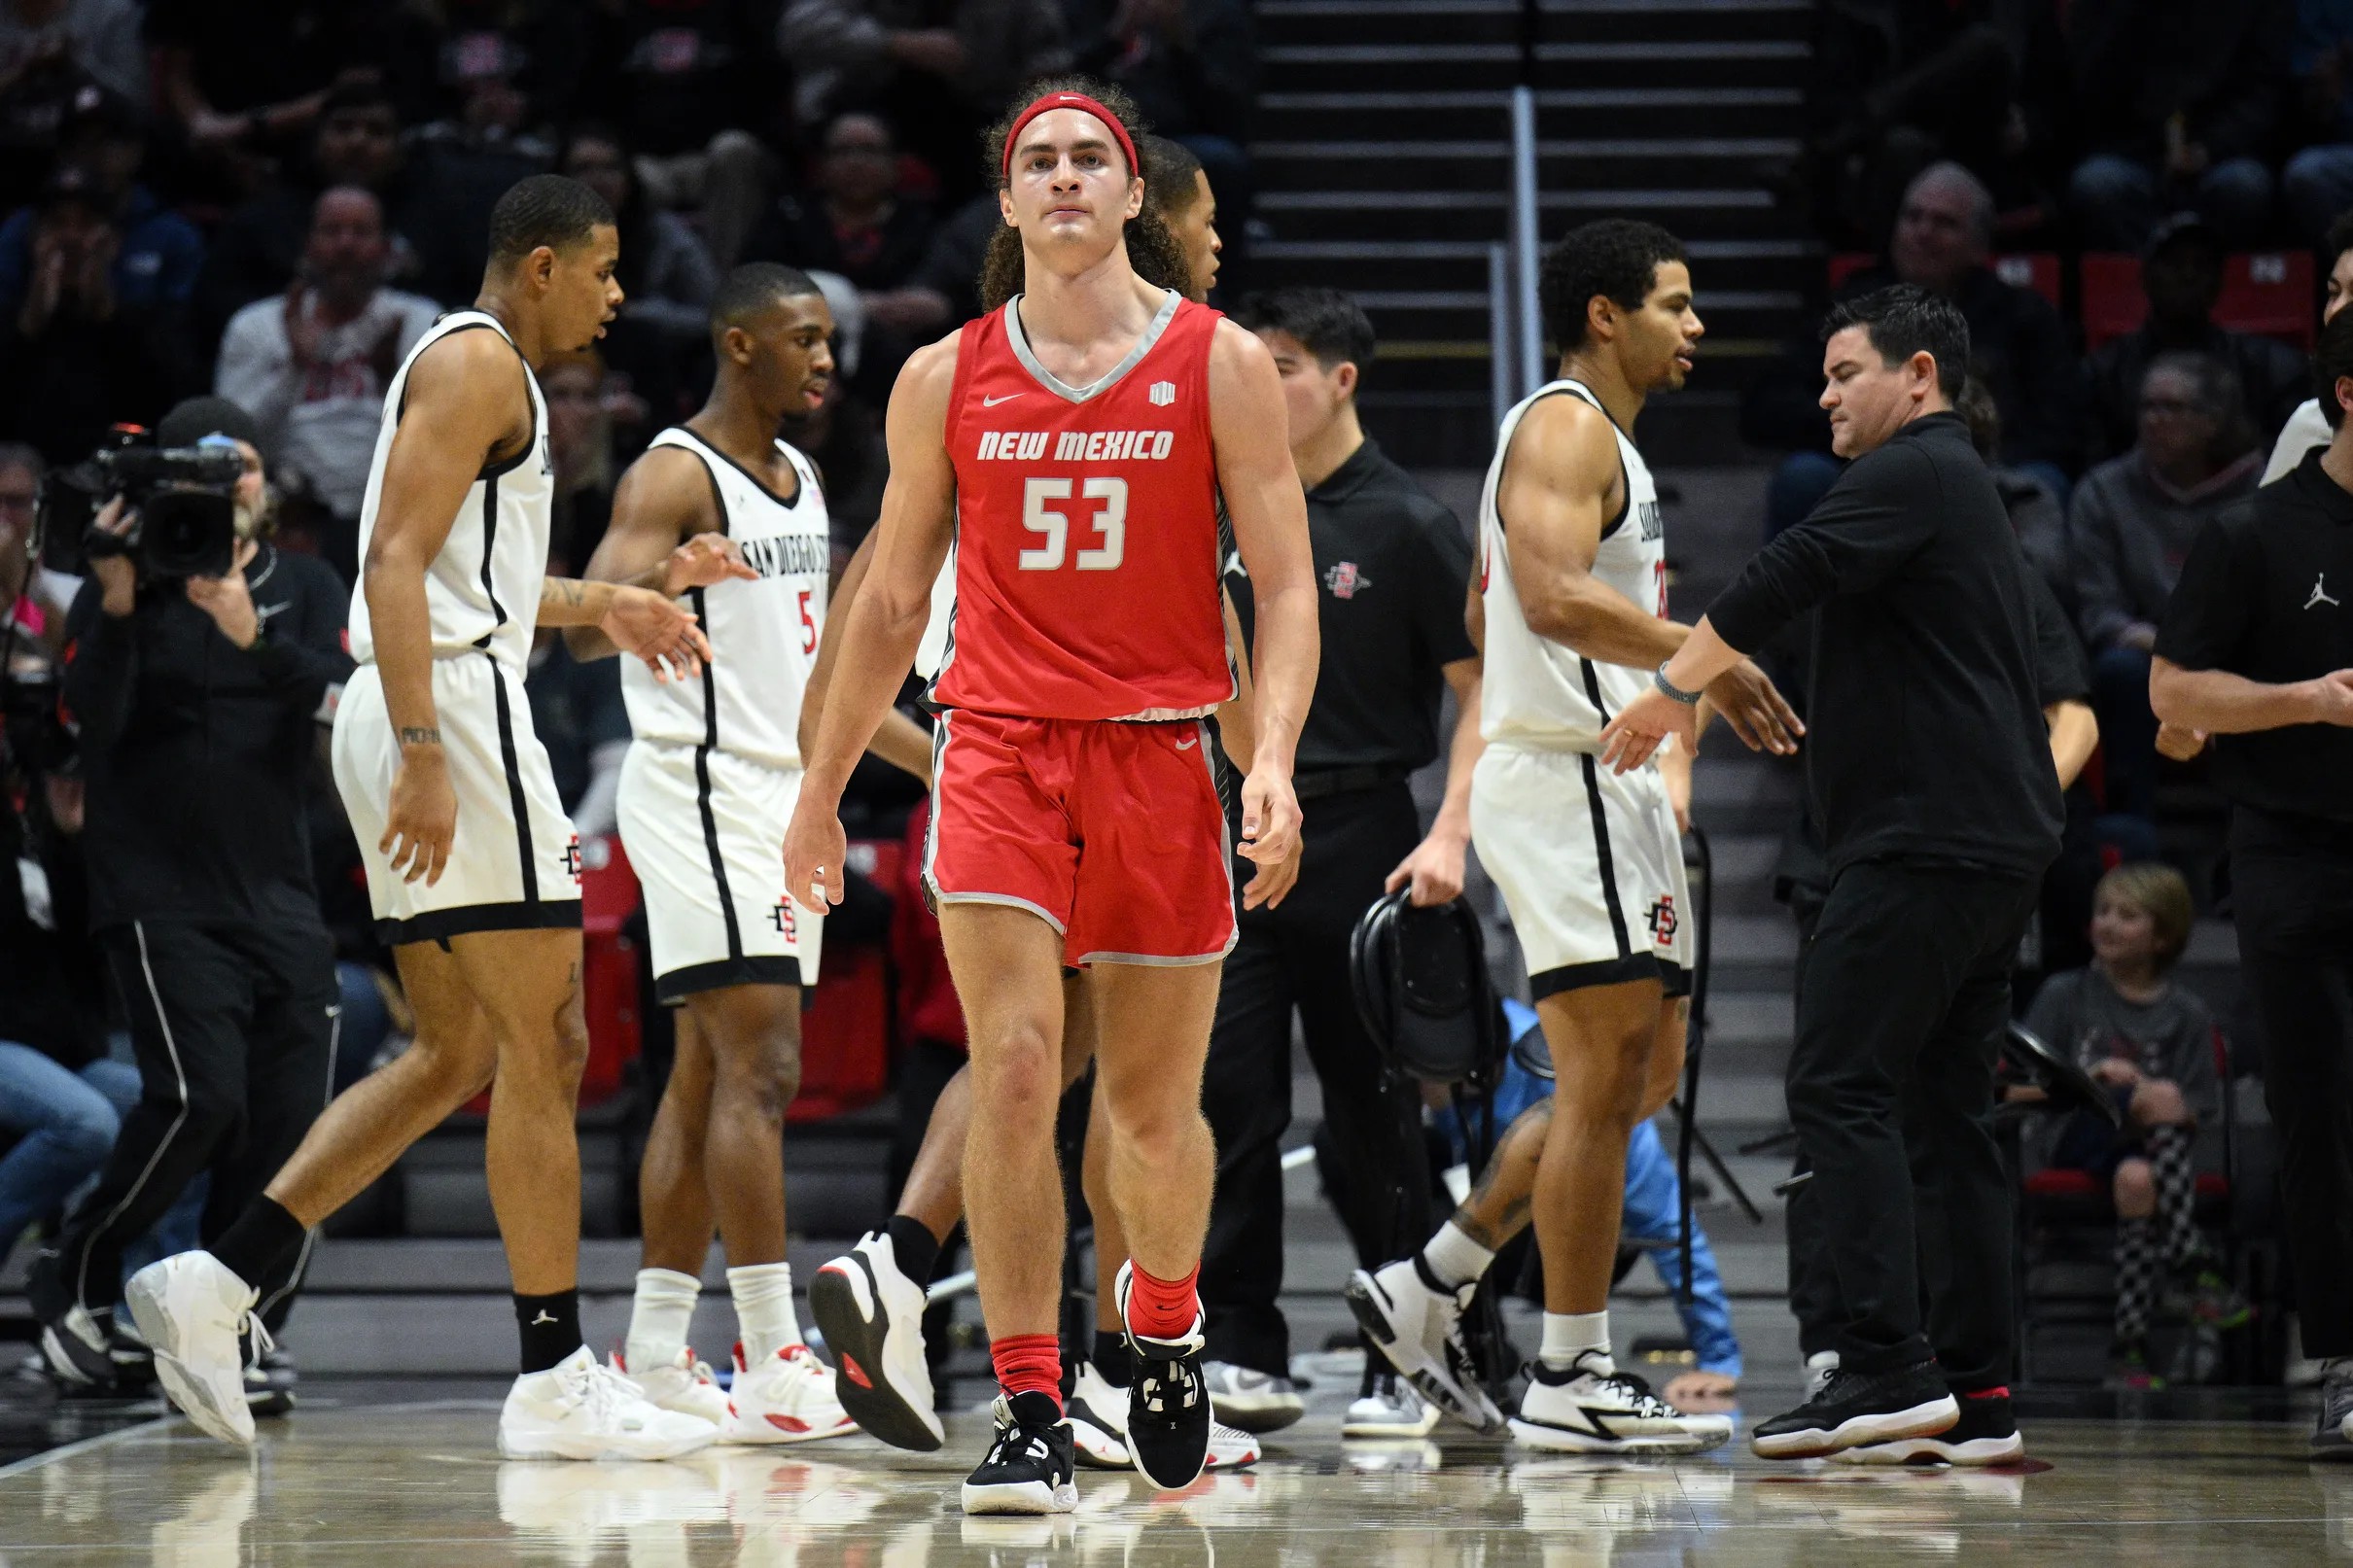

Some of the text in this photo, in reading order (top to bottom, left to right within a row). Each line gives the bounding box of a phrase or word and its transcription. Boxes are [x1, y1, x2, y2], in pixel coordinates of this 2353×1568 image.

[976, 430, 1175, 461] NEW MEXICO
[1018, 476, 1129, 571] 53
[798, 590, 816, 654] 5
